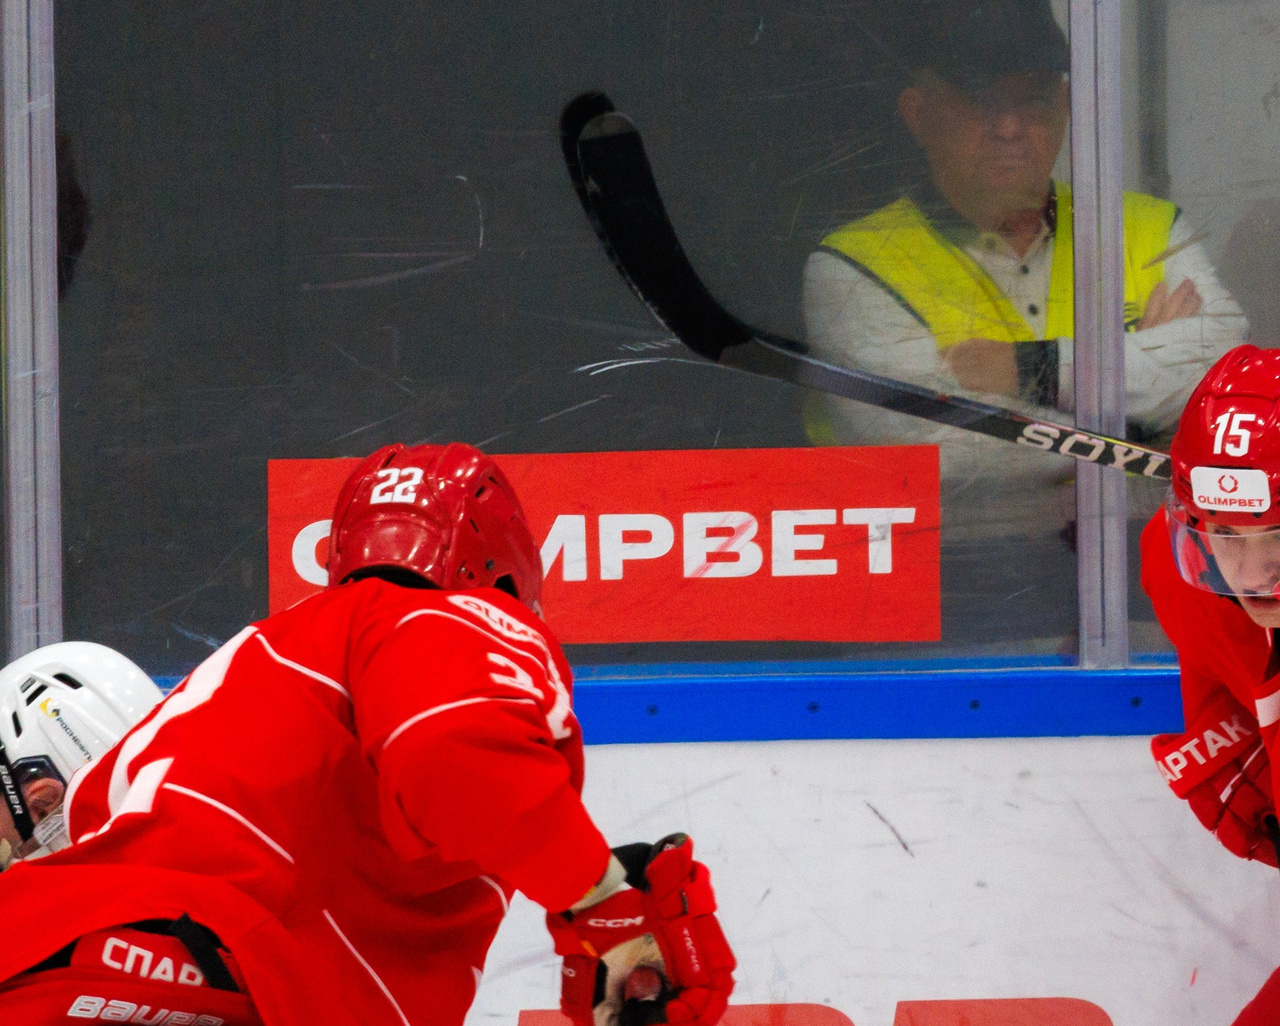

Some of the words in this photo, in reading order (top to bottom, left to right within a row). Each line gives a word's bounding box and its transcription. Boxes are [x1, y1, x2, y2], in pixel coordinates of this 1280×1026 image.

[1212, 413, 1257, 458] 15
[368, 467, 424, 505] 22
[1197, 494, 1266, 508] OLIMPBET
[290, 506, 917, 586] OMPBET
[586, 915, 645, 928] CCM
